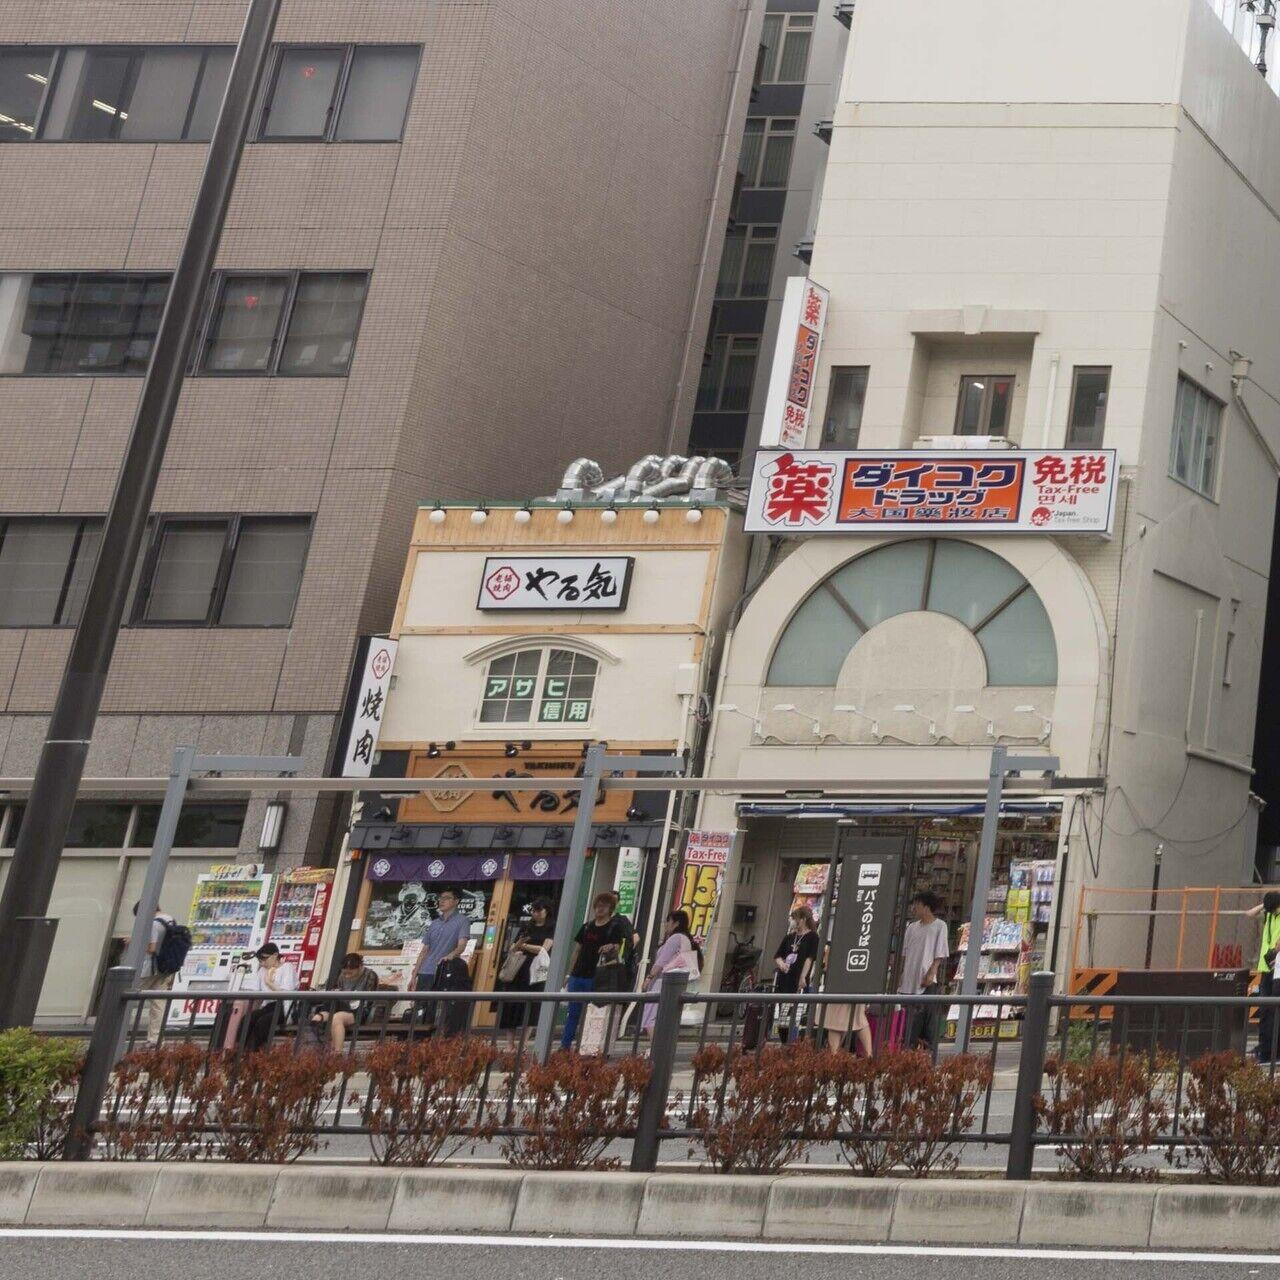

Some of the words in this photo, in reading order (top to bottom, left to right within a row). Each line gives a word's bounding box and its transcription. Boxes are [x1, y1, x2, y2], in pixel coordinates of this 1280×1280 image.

[852, 463, 1017, 489] ダイコク
[1033, 455, 1107, 485] 免税
[763, 453, 834, 524] 薬
[874, 490, 986, 506] ドラッグ
[1038, 485, 1100, 494] Tax-Free
[525, 562, 617, 603] やる気
[543, 702, 587, 719] 信用
[352, 686, 384, 766] 焼肉
[688, 847, 727, 860] Tax-Free
[858, 889, 877, 947] バスのりば
[849, 954, 867, 966] G2
